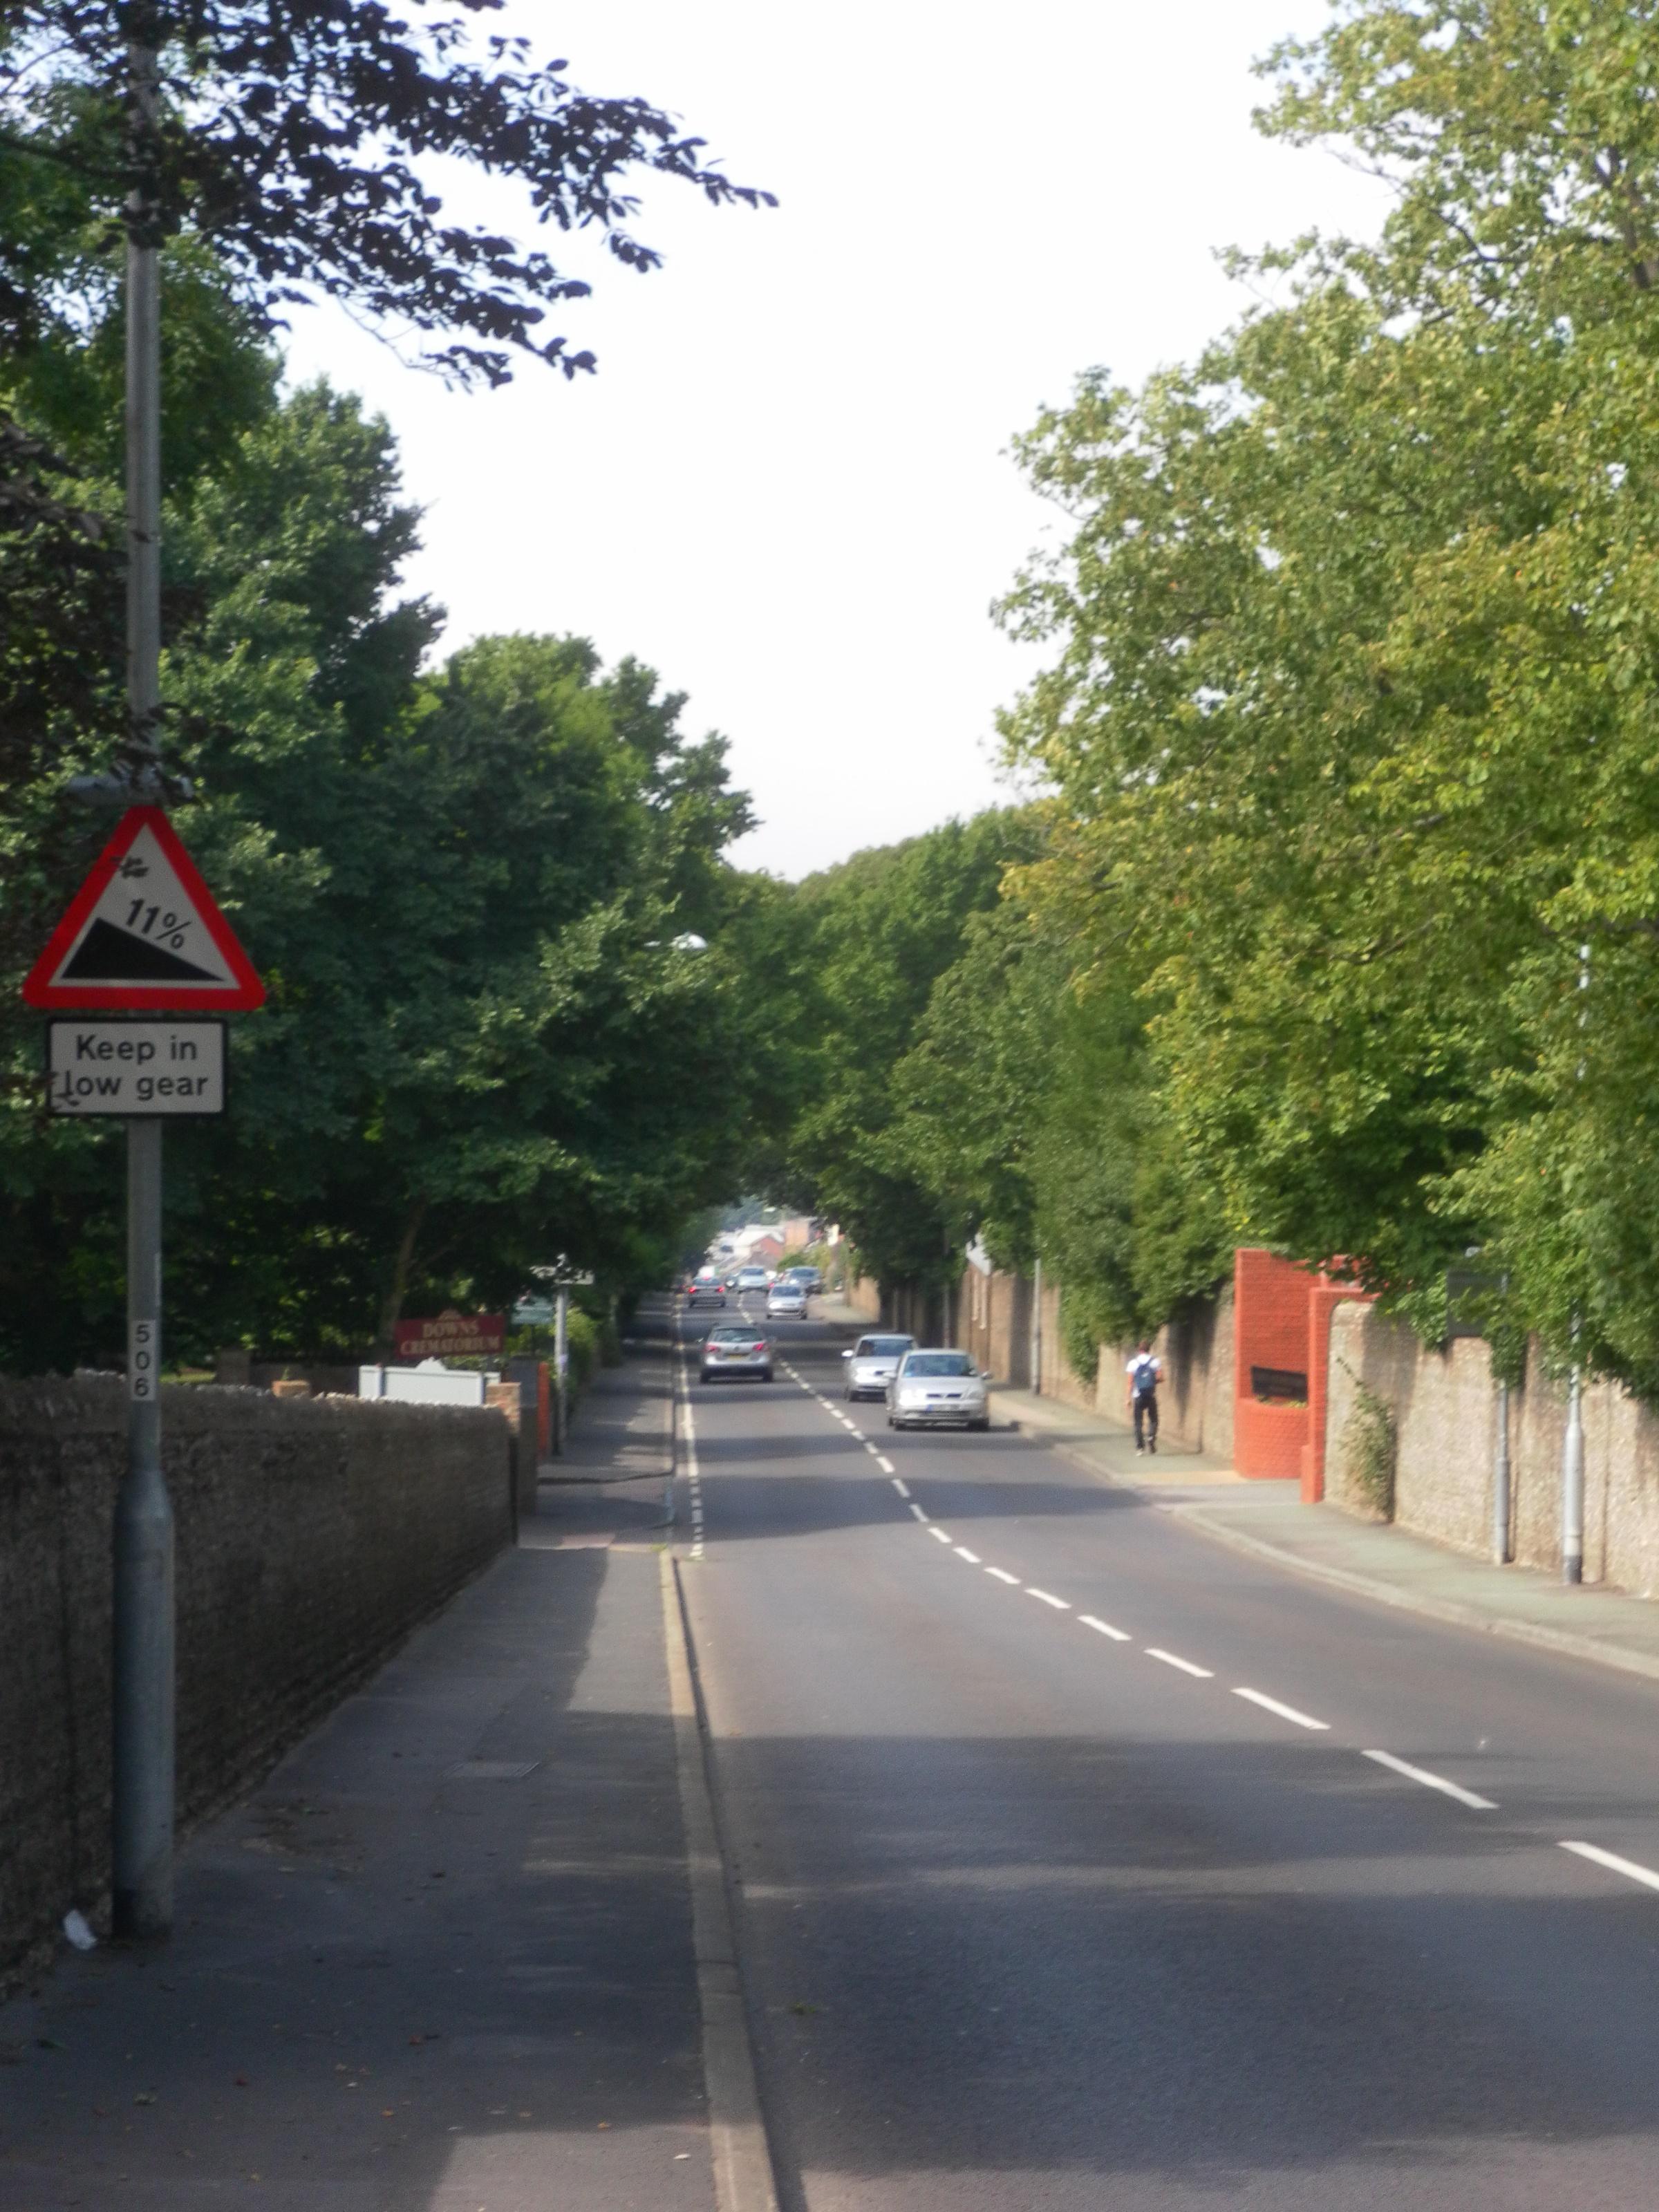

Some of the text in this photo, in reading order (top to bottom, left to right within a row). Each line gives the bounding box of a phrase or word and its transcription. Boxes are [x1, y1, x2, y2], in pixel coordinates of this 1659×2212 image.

[126, 899, 191, 949] 11%
[76, 1035, 197, 1065] Keep in
[66, 1071, 208, 1101] low gear
[135, 1324, 150, 1397] 506
